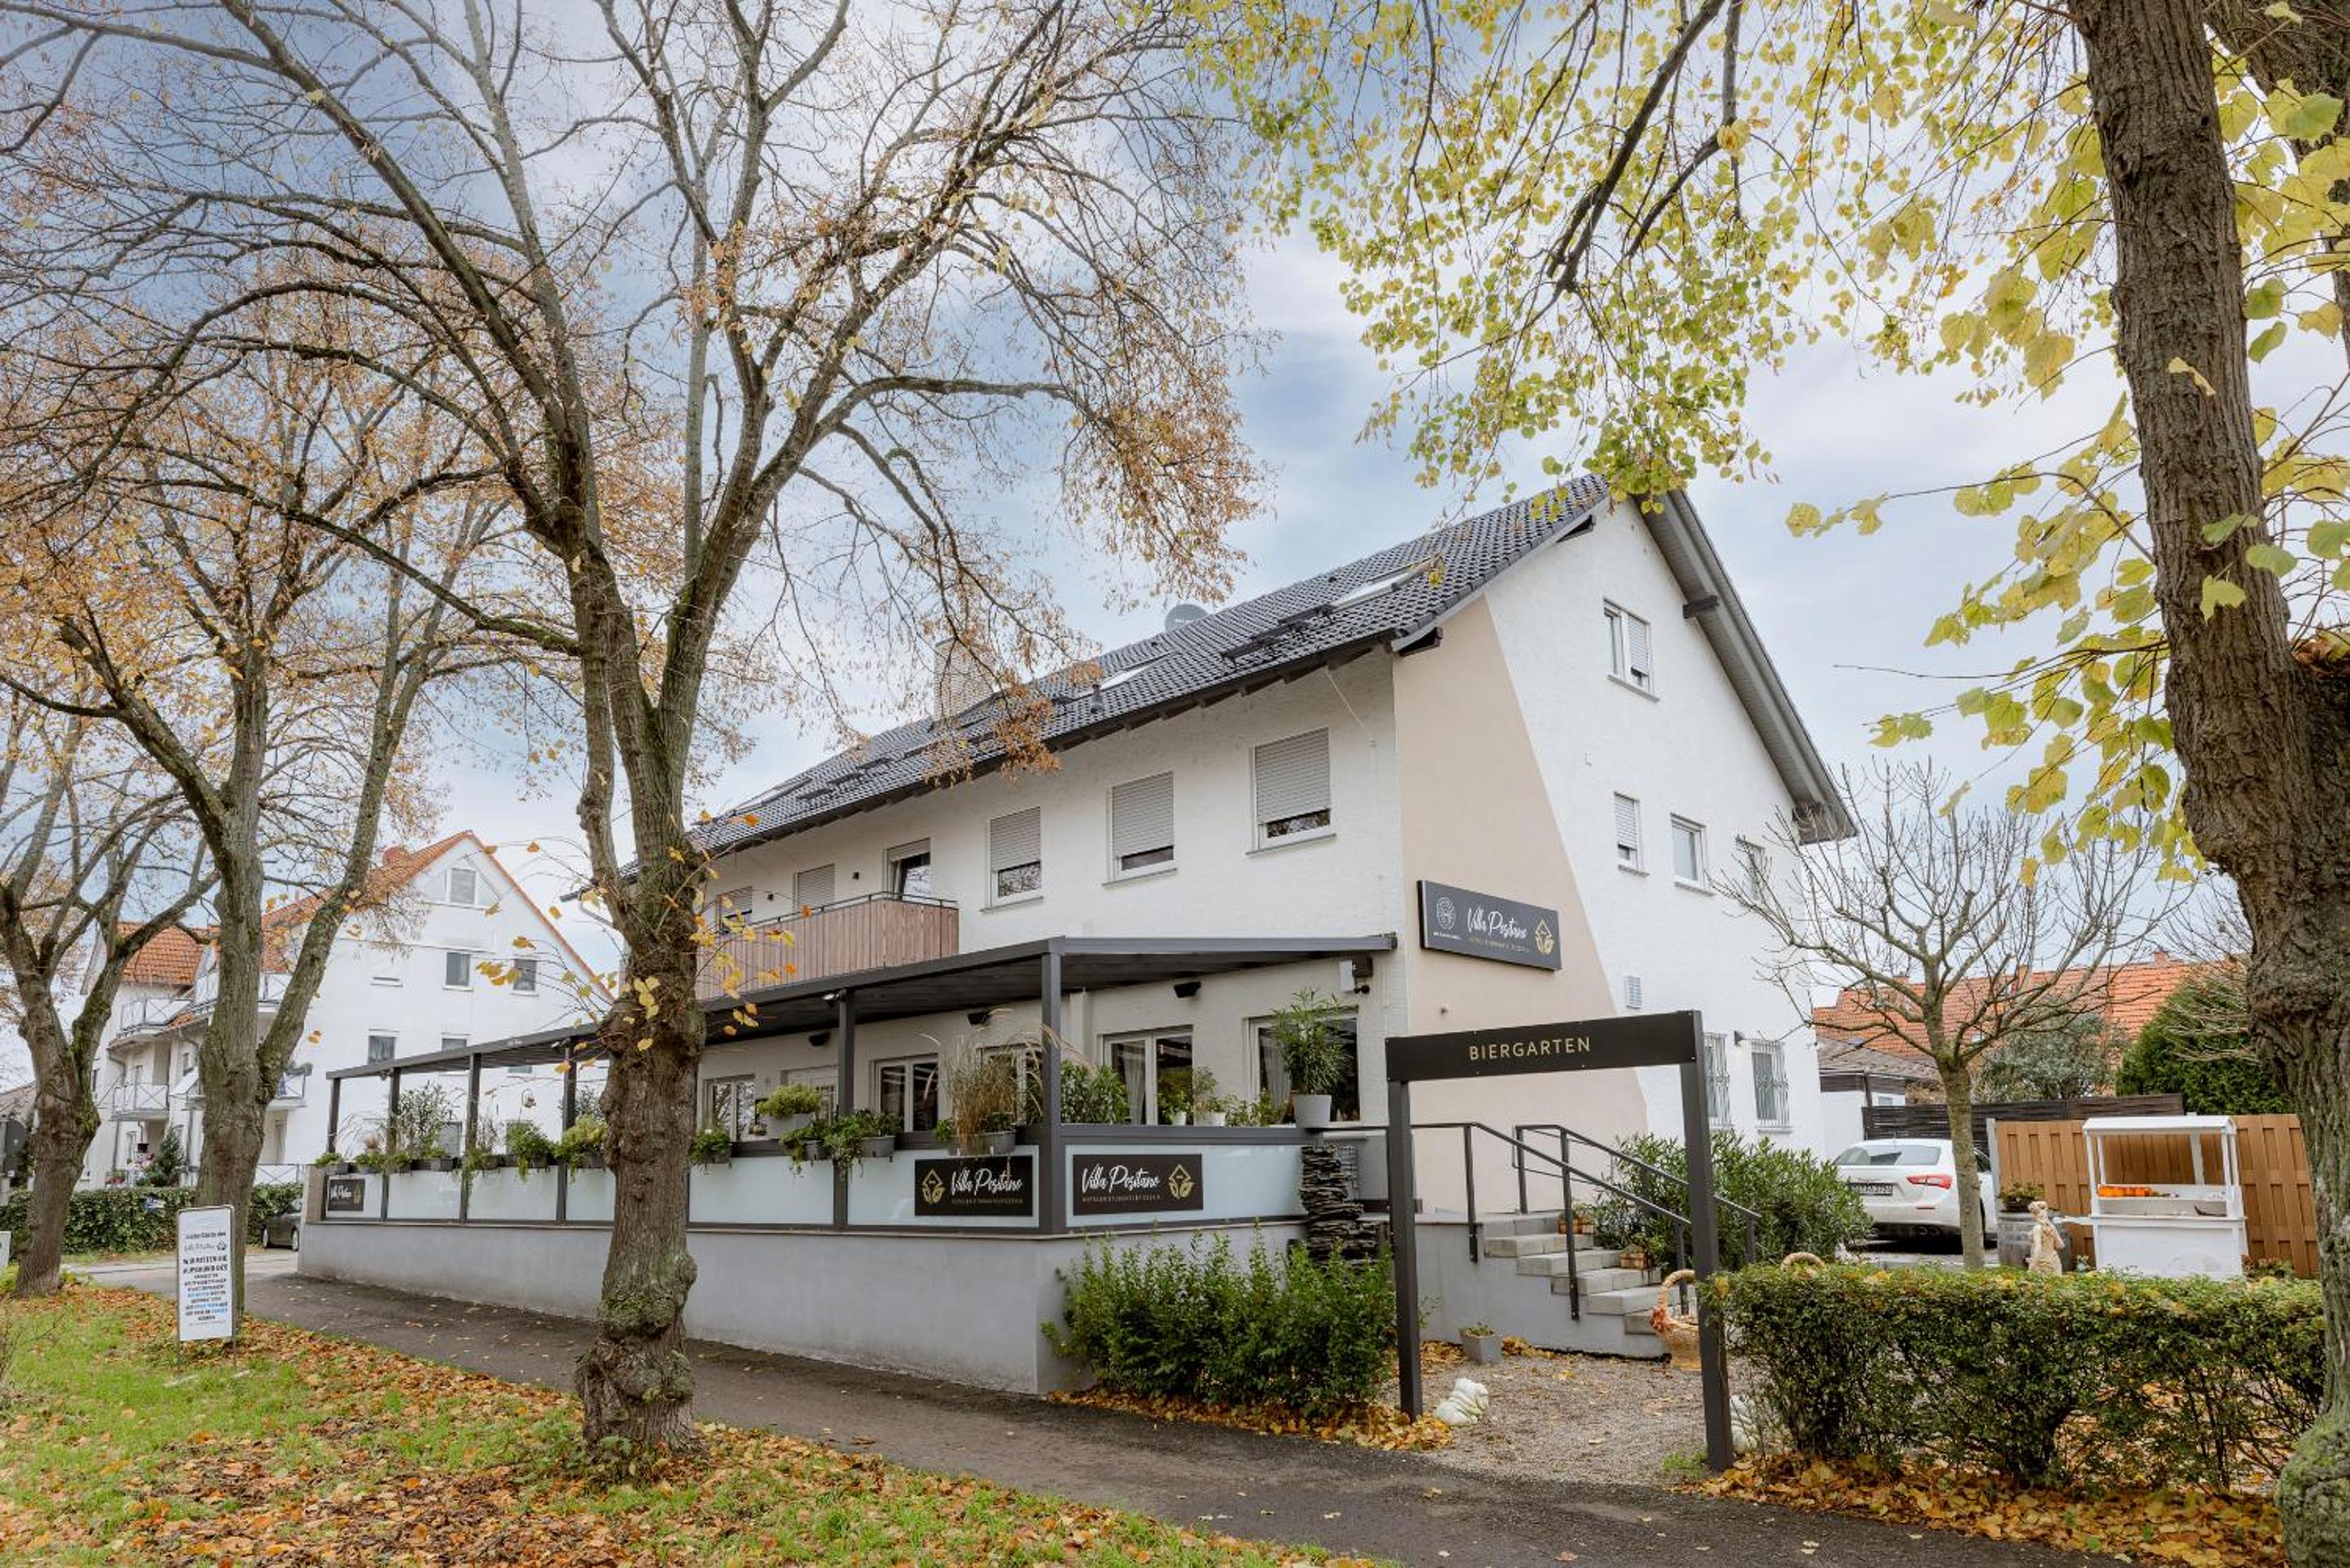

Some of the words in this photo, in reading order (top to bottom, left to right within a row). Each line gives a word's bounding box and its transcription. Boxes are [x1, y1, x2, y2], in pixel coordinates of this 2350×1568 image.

[1468, 905, 1488, 932] Villa
[1469, 1036, 1591, 1061] BIERGARTEN
[951, 1167, 973, 1196] Villa
[974, 1167, 1023, 1196] Positano
[1082, 1163, 1107, 1194] Villa
[1109, 1164, 1160, 1194] Positano
